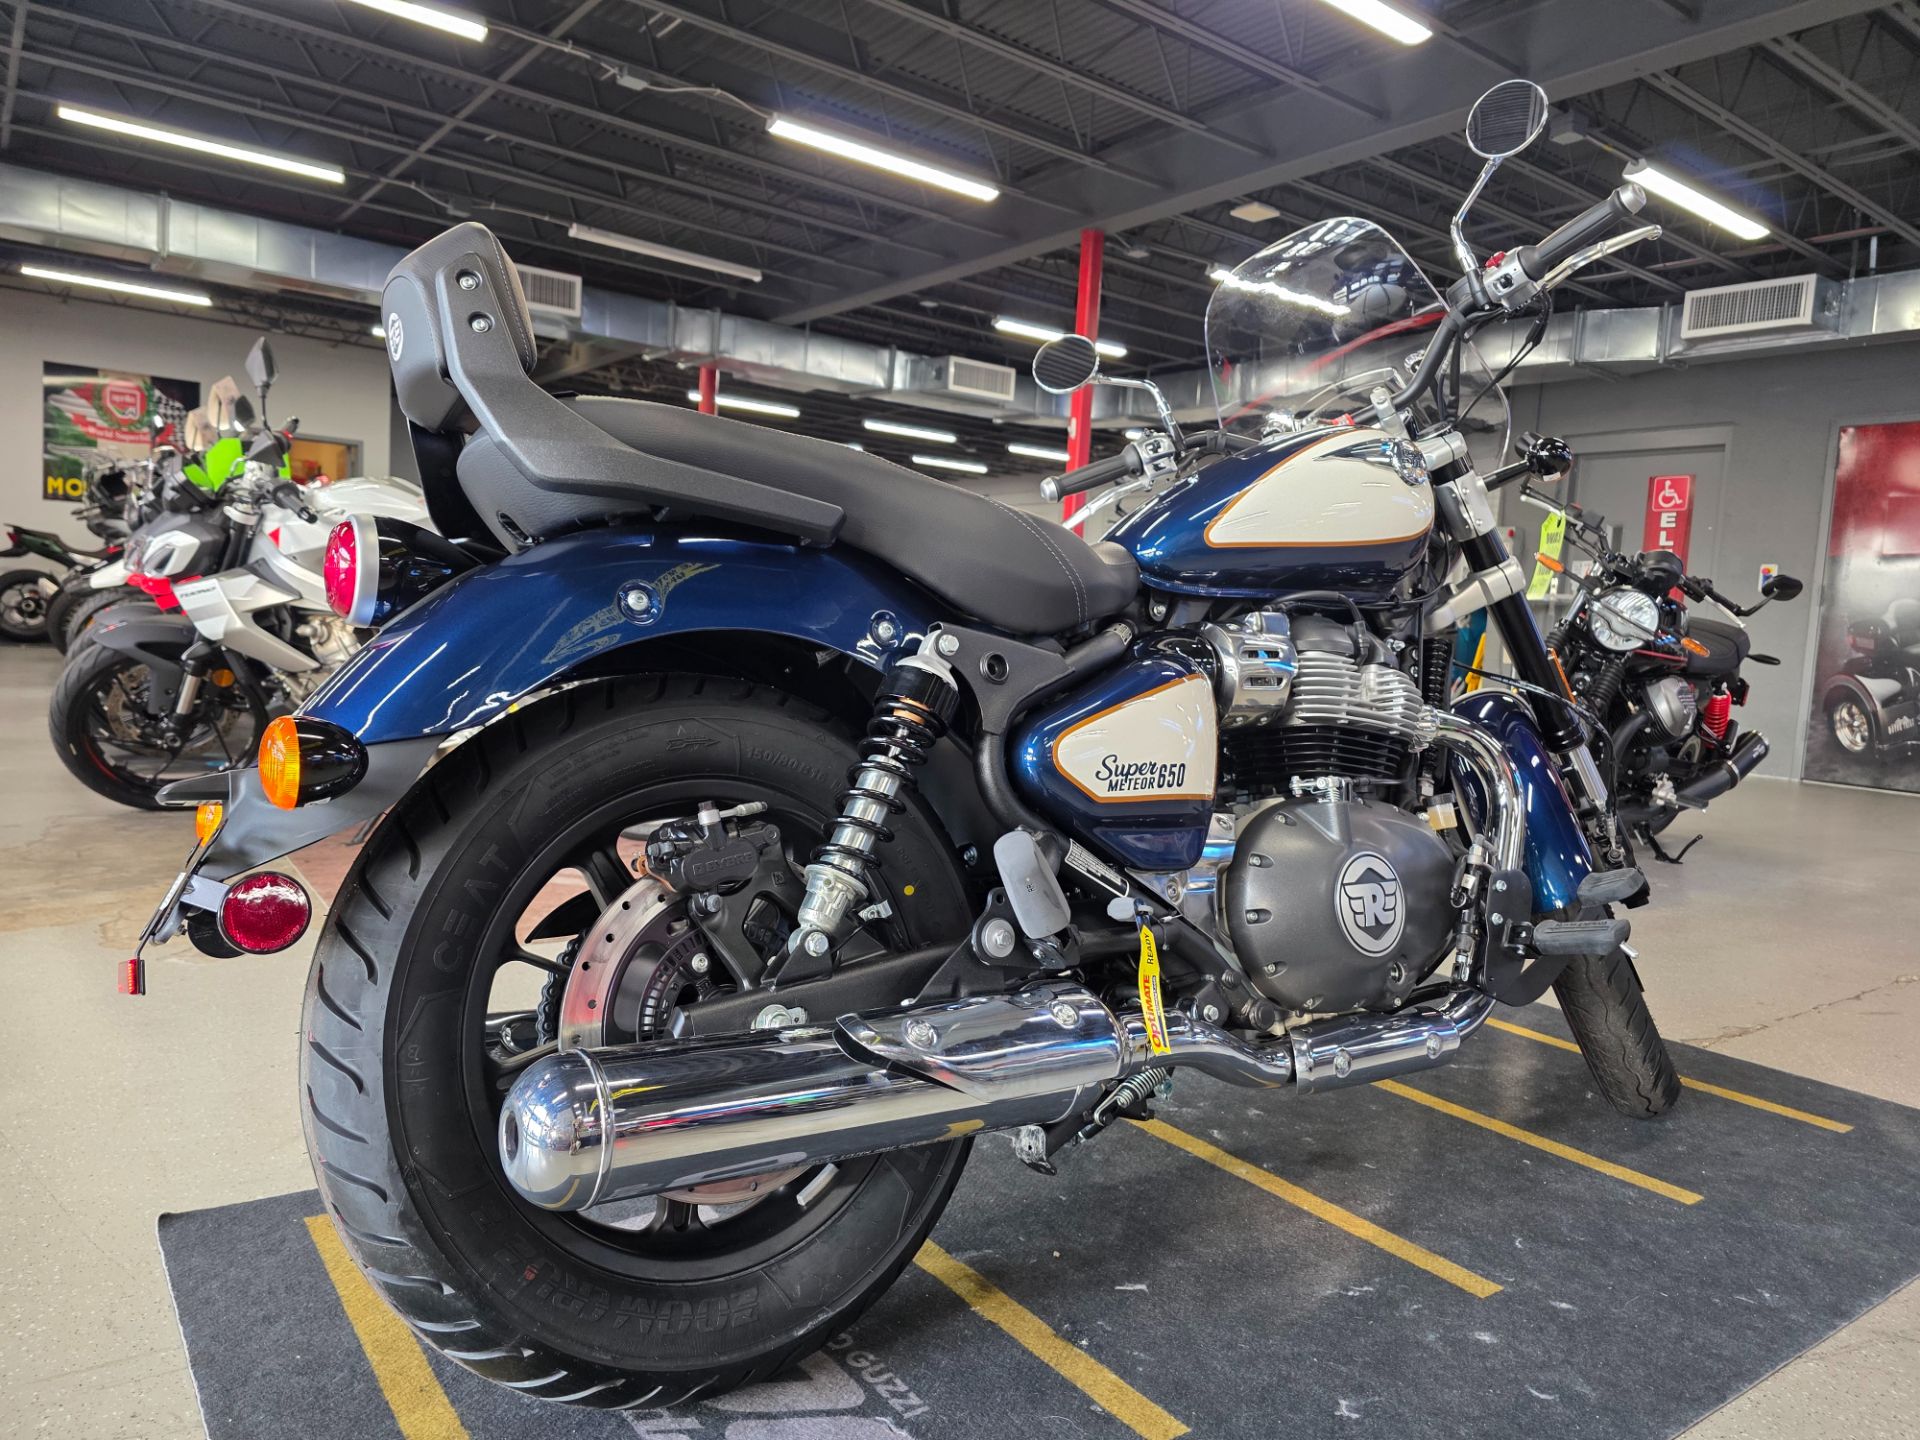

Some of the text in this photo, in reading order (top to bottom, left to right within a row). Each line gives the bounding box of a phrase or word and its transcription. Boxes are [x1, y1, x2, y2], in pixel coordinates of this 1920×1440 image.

[47, 475, 85, 497] MO
[1658, 511, 1677, 552] EL
[1095, 754, 1186, 789] Super 650
[1107, 777, 1156, 792] METEOR
[1144, 933, 1154, 965] READY
[846, 1349, 930, 1420] GUZZI
